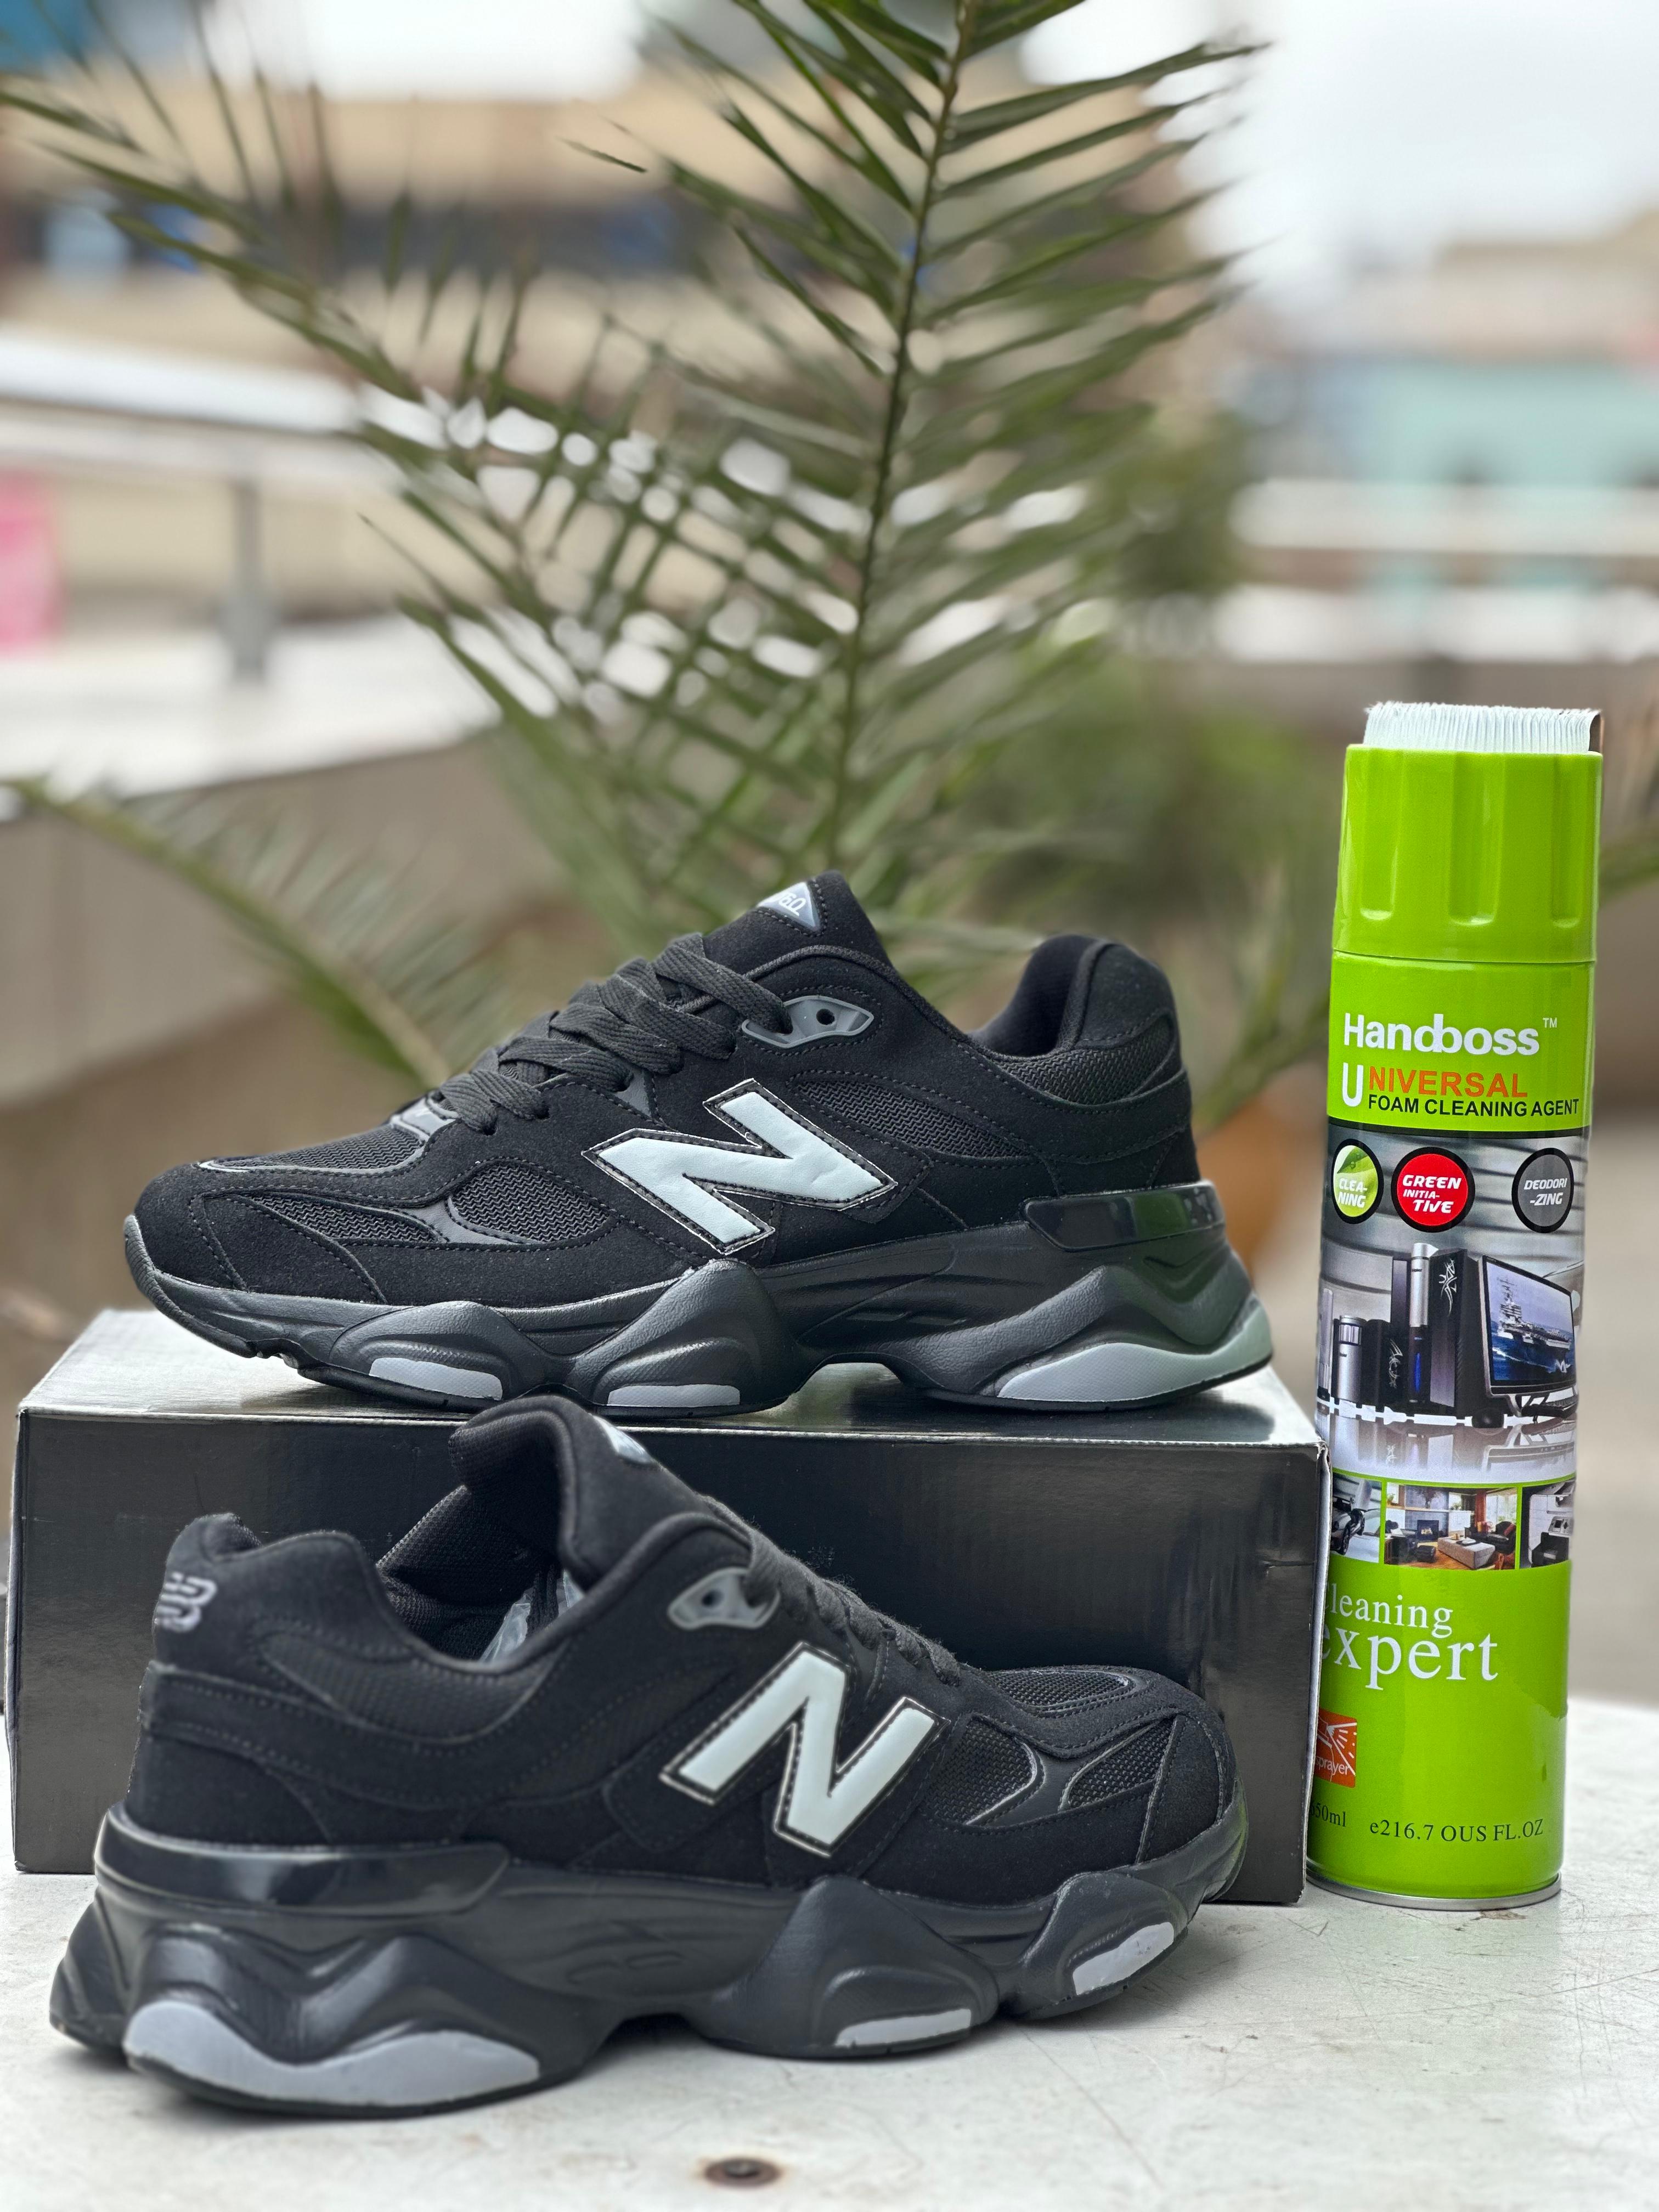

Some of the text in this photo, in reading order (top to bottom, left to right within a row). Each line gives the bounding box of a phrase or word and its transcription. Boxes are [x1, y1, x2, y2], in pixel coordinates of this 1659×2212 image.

[1344, 1012, 1540, 1056] Handboss
[1368, 1094, 1579, 1117] FOAM CLEANING AGENT
[581, 1078, 899, 1255] N
[1339, 1178, 1368, 1193] CLEA-
[1402, 1174, 1462, 1189] GREEN
[1523, 1178, 1567, 1190] DEODORI
[1338, 1191, 1366, 1208] NING
[1403, 1189, 1440, 1199] INITIA-
[1413, 1199, 1454, 1214] TIVE
[1325, 1583, 1453, 1639] leaning
[658, 1641, 952, 1858] N
